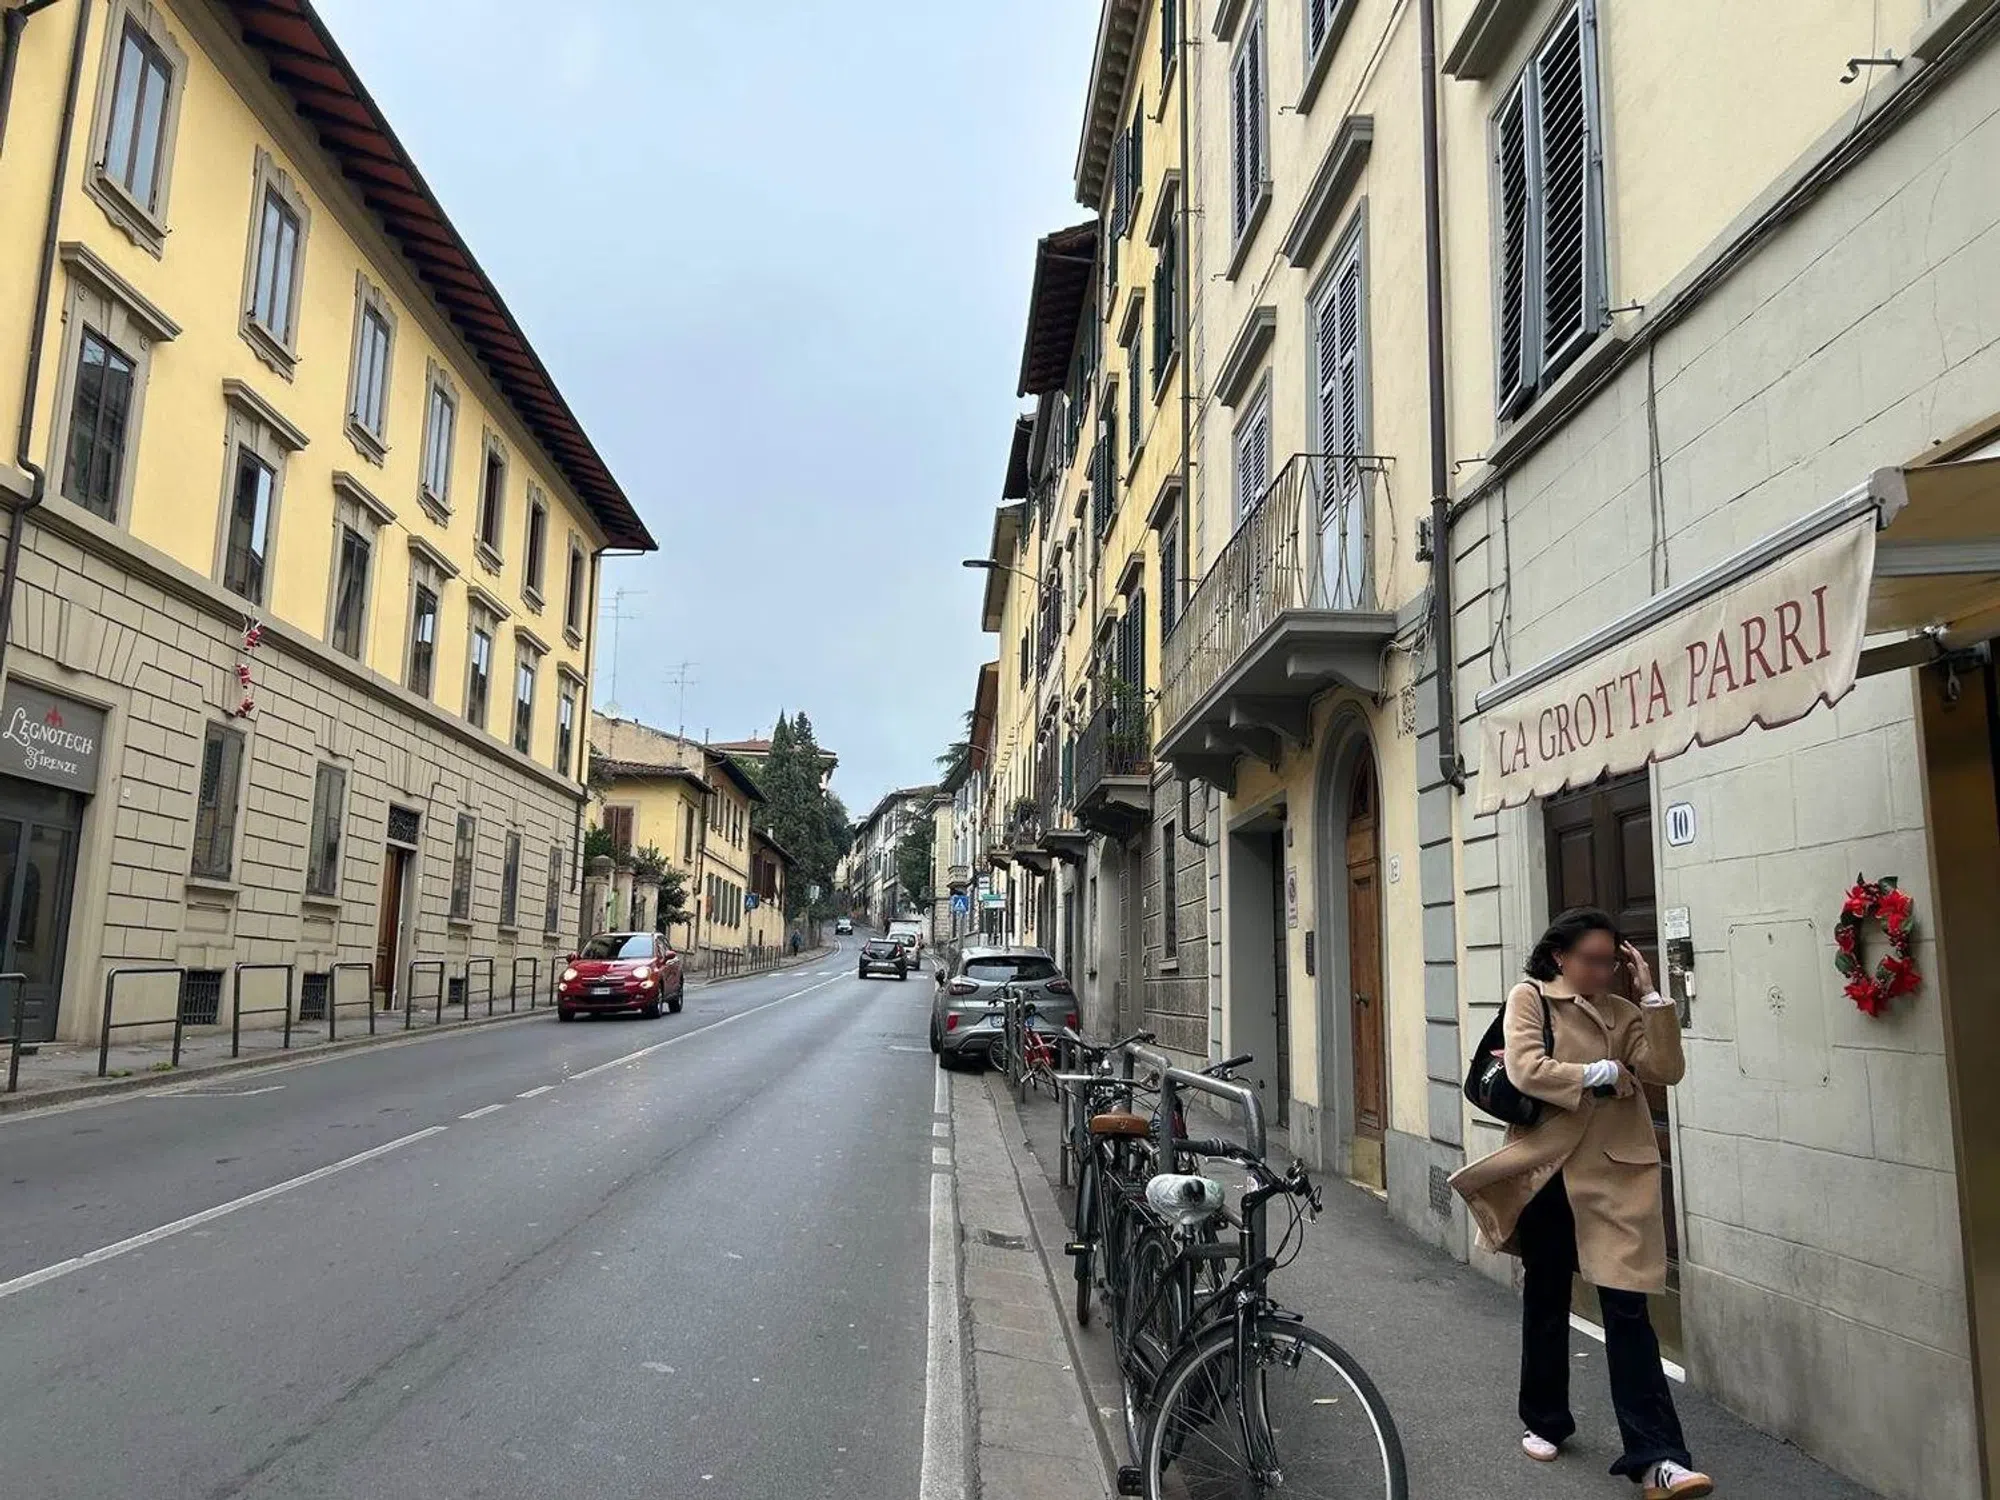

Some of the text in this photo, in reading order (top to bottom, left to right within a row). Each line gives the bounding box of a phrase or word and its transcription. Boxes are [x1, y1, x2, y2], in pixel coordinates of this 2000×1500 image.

[1499, 585, 1832, 778] LA GROTTA PARRI
[1673, 809, 1689, 840] 10
